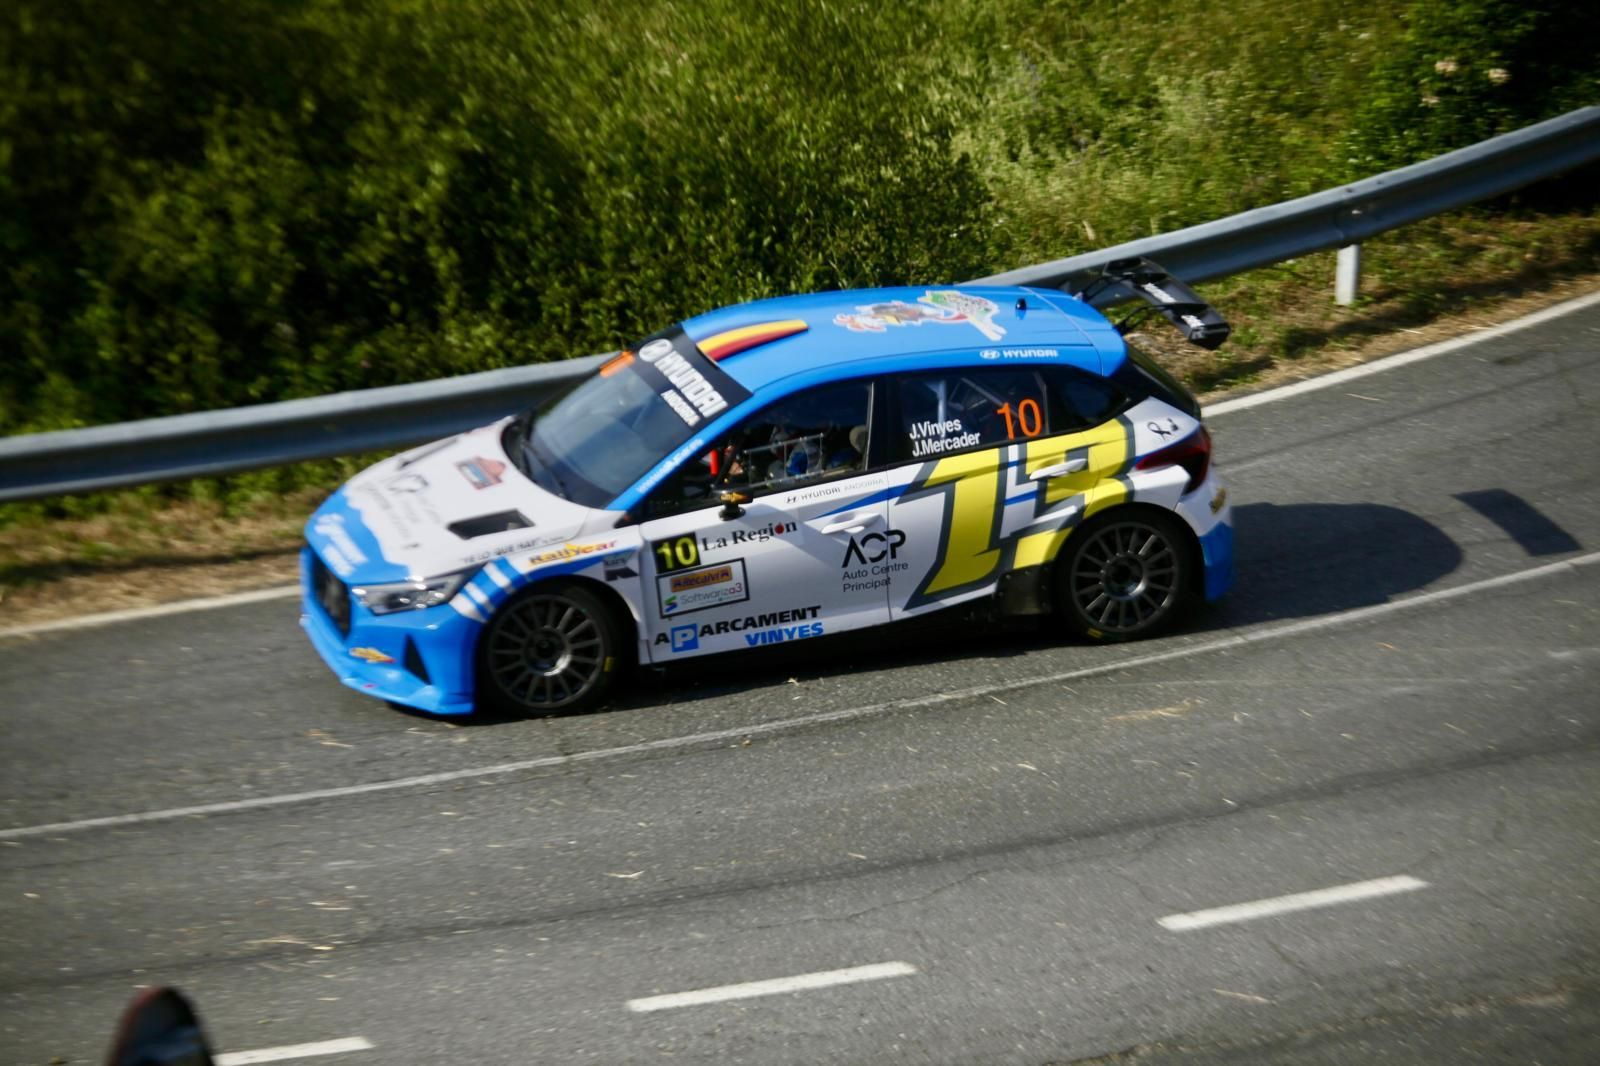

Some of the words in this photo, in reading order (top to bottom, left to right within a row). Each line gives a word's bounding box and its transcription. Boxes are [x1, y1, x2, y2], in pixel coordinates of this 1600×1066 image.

[1003, 349, 1058, 358] HYUNDAI
[654, 350, 728, 418] HYUNDAI
[909, 418, 962, 440] J.Vinyes
[997, 398, 1042, 442] 10
[912, 432, 981, 457] J.Mercader
[656, 537, 697, 569] 10
[702, 537, 727, 551] La
[841, 529, 906, 568] ACP
[842, 570, 868, 580] Auto
[871, 562, 909, 576] Centre
[843, 577, 891, 592] Principal
[745, 622, 824, 646] VINYES
